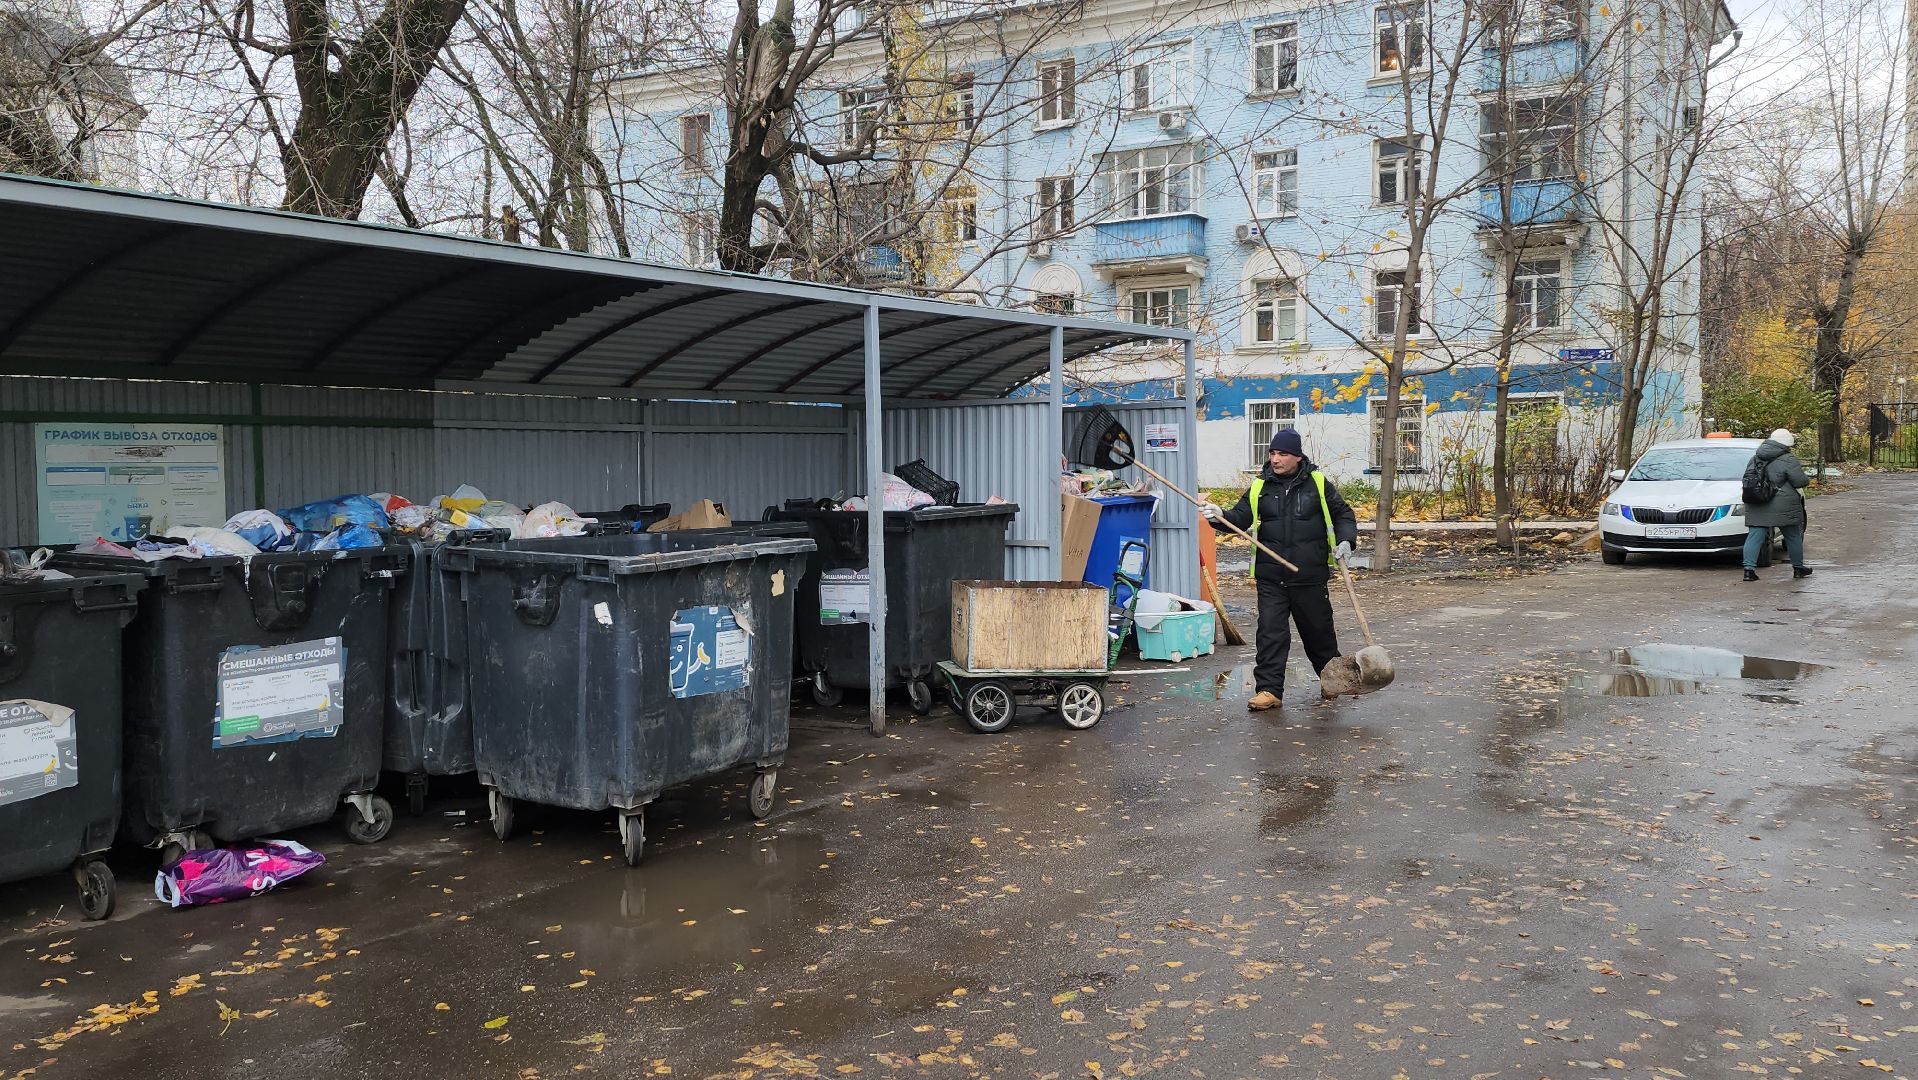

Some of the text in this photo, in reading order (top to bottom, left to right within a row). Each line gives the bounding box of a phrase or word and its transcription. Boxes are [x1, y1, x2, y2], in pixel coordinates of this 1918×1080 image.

[45, 430, 218, 442] ГРАФИК ВЫВОЗА ОТХОДОВ
[223, 654, 293, 671] СМЕШАННЫЕ
[294, 647, 336, 660] ОТХОДЫ
[11, 704, 37, 716] ОТХ
